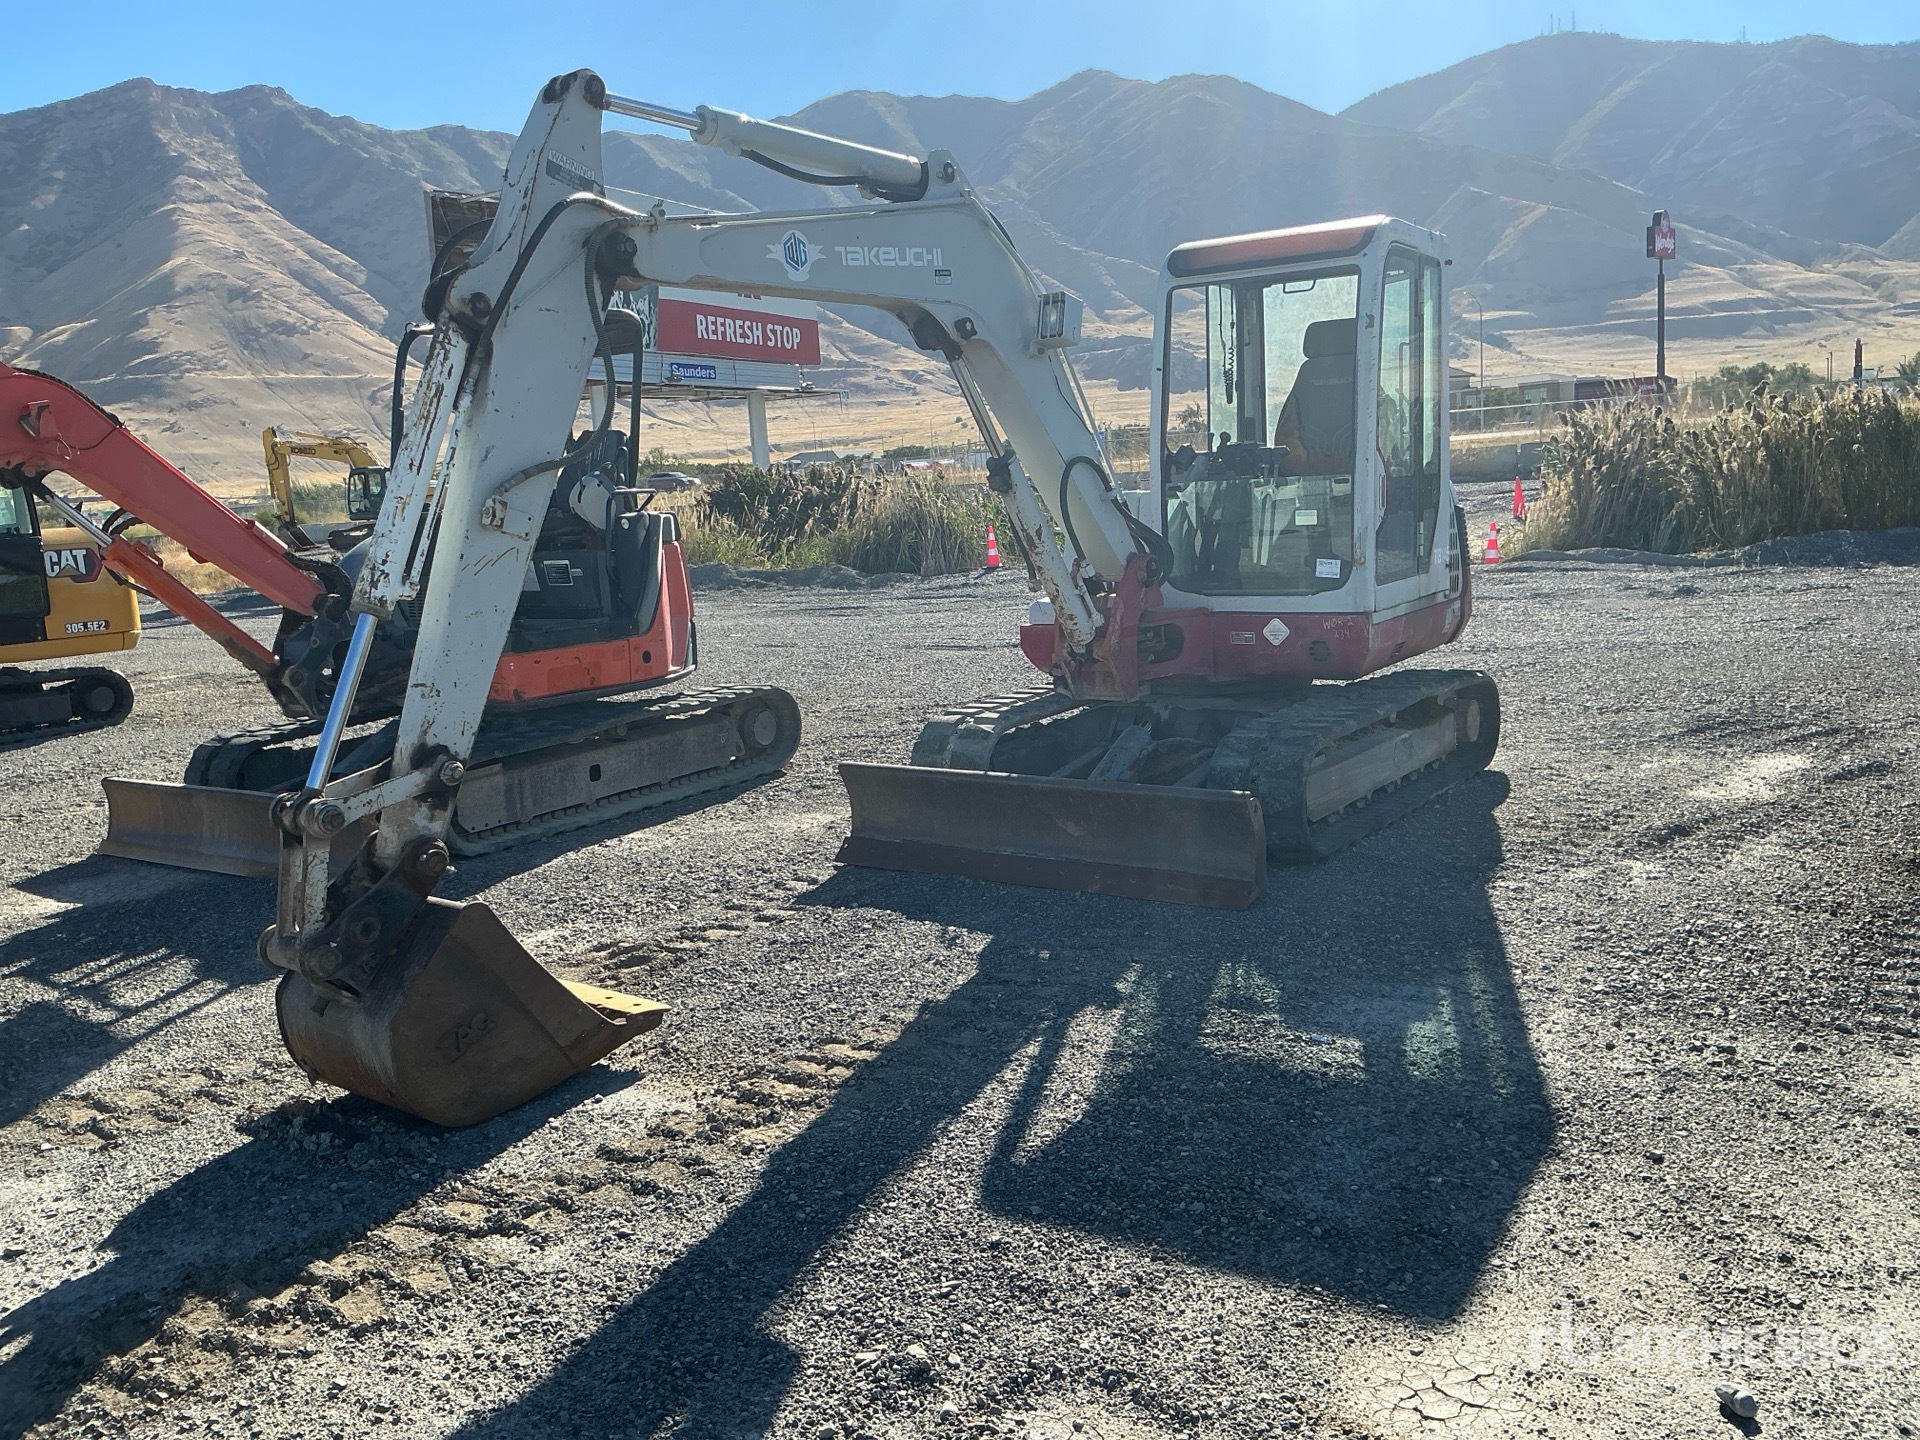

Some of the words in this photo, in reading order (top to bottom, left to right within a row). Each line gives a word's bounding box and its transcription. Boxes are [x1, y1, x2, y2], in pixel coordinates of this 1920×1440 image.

[549, 150, 595, 181] WARNING
[834, 246, 943, 267] TAKEUCHI
[696, 313, 764, 346] REFRESH
[767, 323, 801, 350] STOP
[671, 364, 716, 379] Saunders
[43, 549, 87, 577] CAT
[65, 620, 107, 634] 305.5E2
